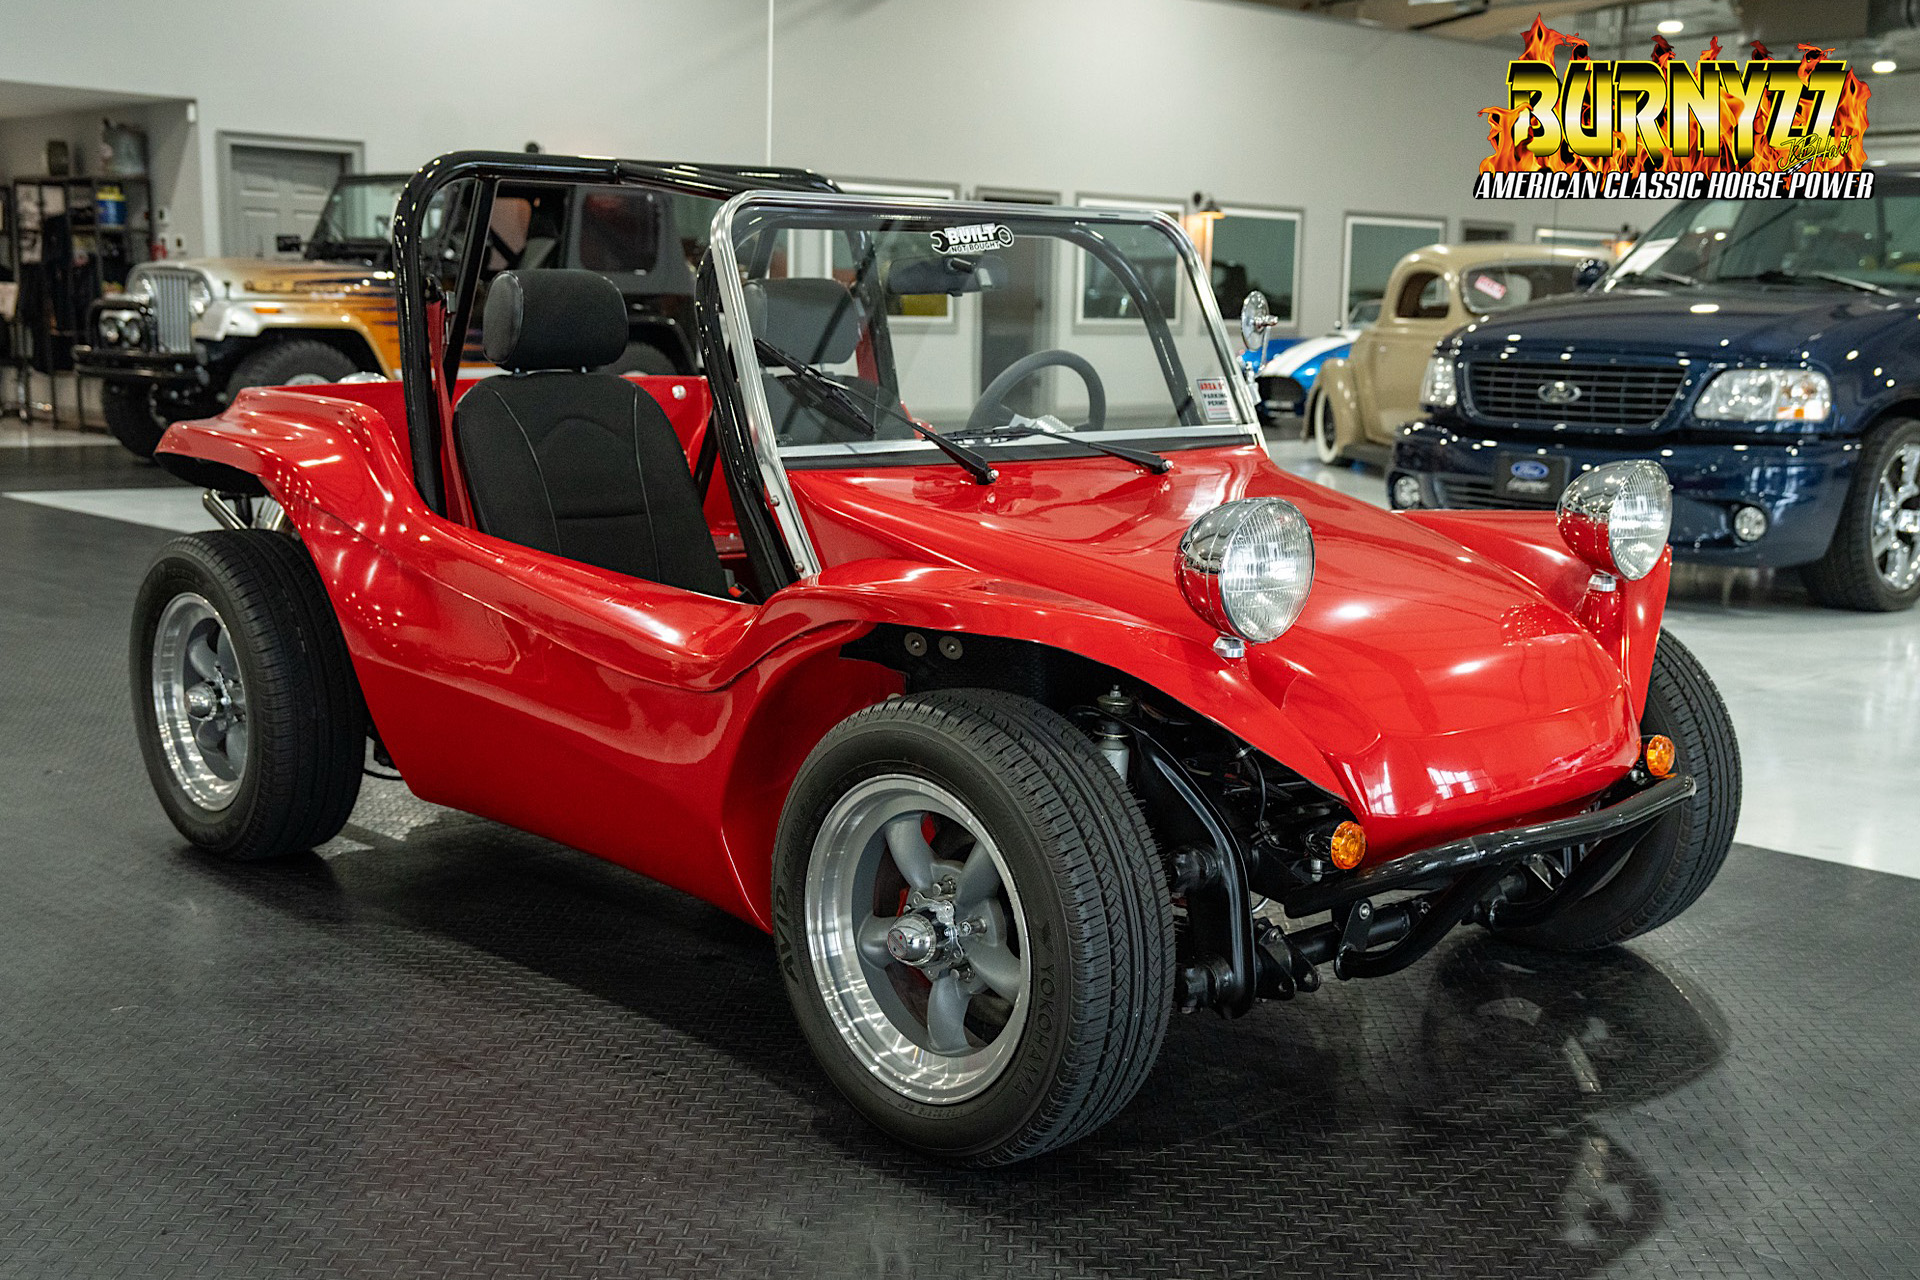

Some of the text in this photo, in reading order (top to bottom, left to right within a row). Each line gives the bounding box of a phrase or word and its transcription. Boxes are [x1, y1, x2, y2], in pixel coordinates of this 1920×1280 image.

[944, 223, 996, 246] BUILT
[951, 240, 1000, 253] NOT BOUGHT
[775, 884, 799, 985] AVID
[1013, 962, 1056, 1097] YOKOHAMA
